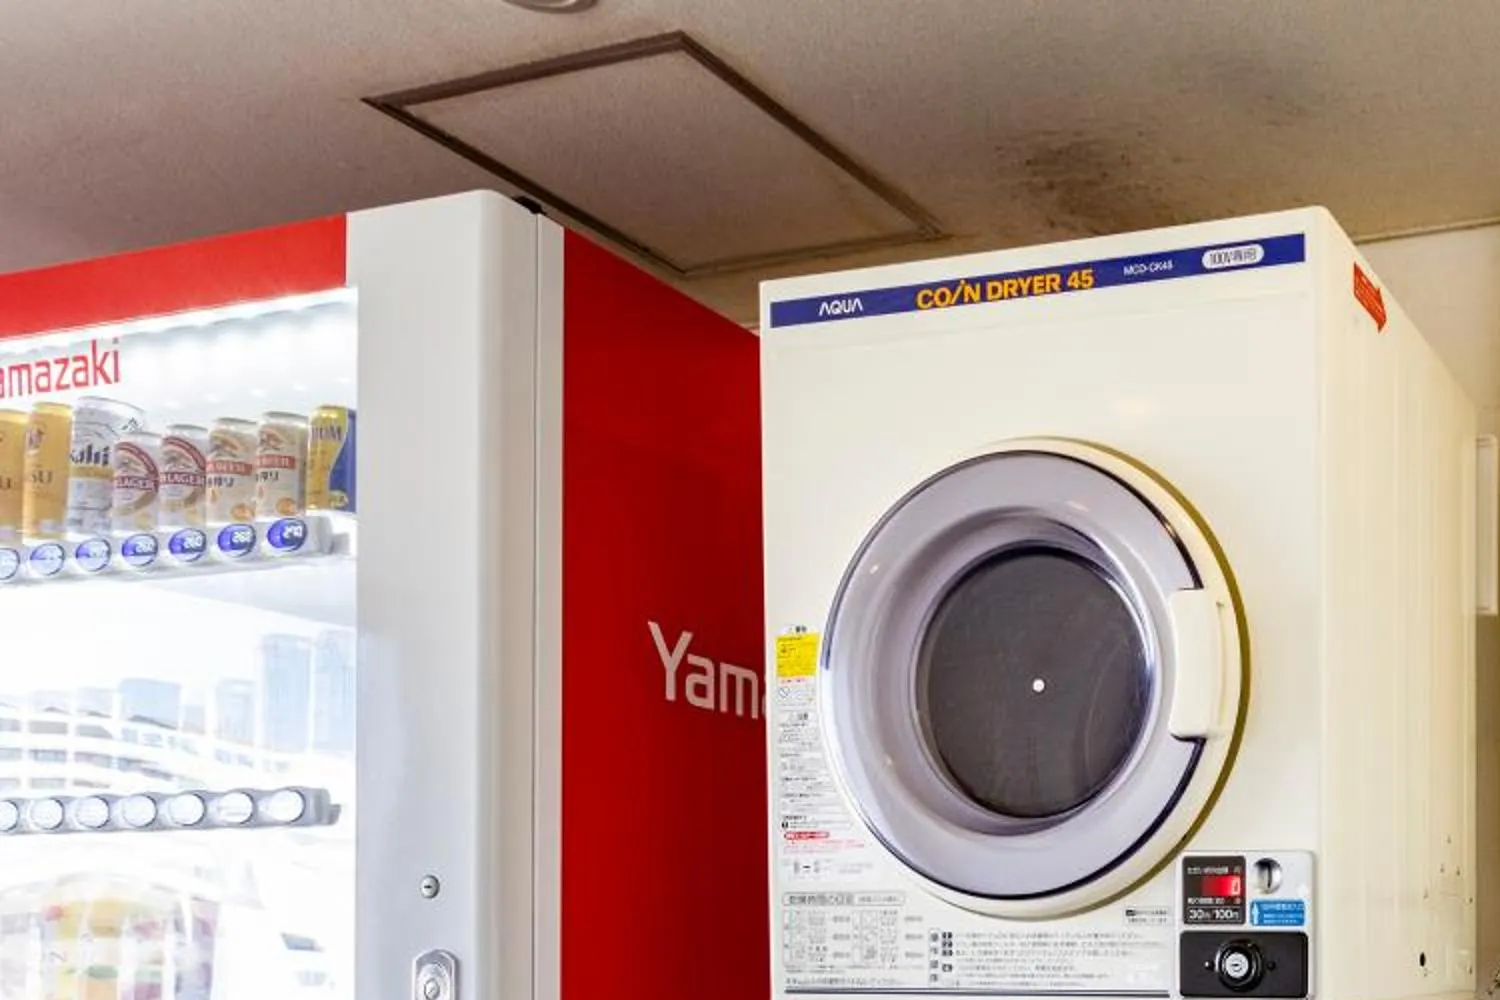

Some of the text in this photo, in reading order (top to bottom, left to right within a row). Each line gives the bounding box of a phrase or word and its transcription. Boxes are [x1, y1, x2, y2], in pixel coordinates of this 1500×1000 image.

[819, 298, 863, 316] AQUA
[916, 279, 980, 309] COIN
[987, 272, 1061, 300] DRYER
[1067, 268, 1094, 289] 45
[648, 620, 766, 720] Yam
